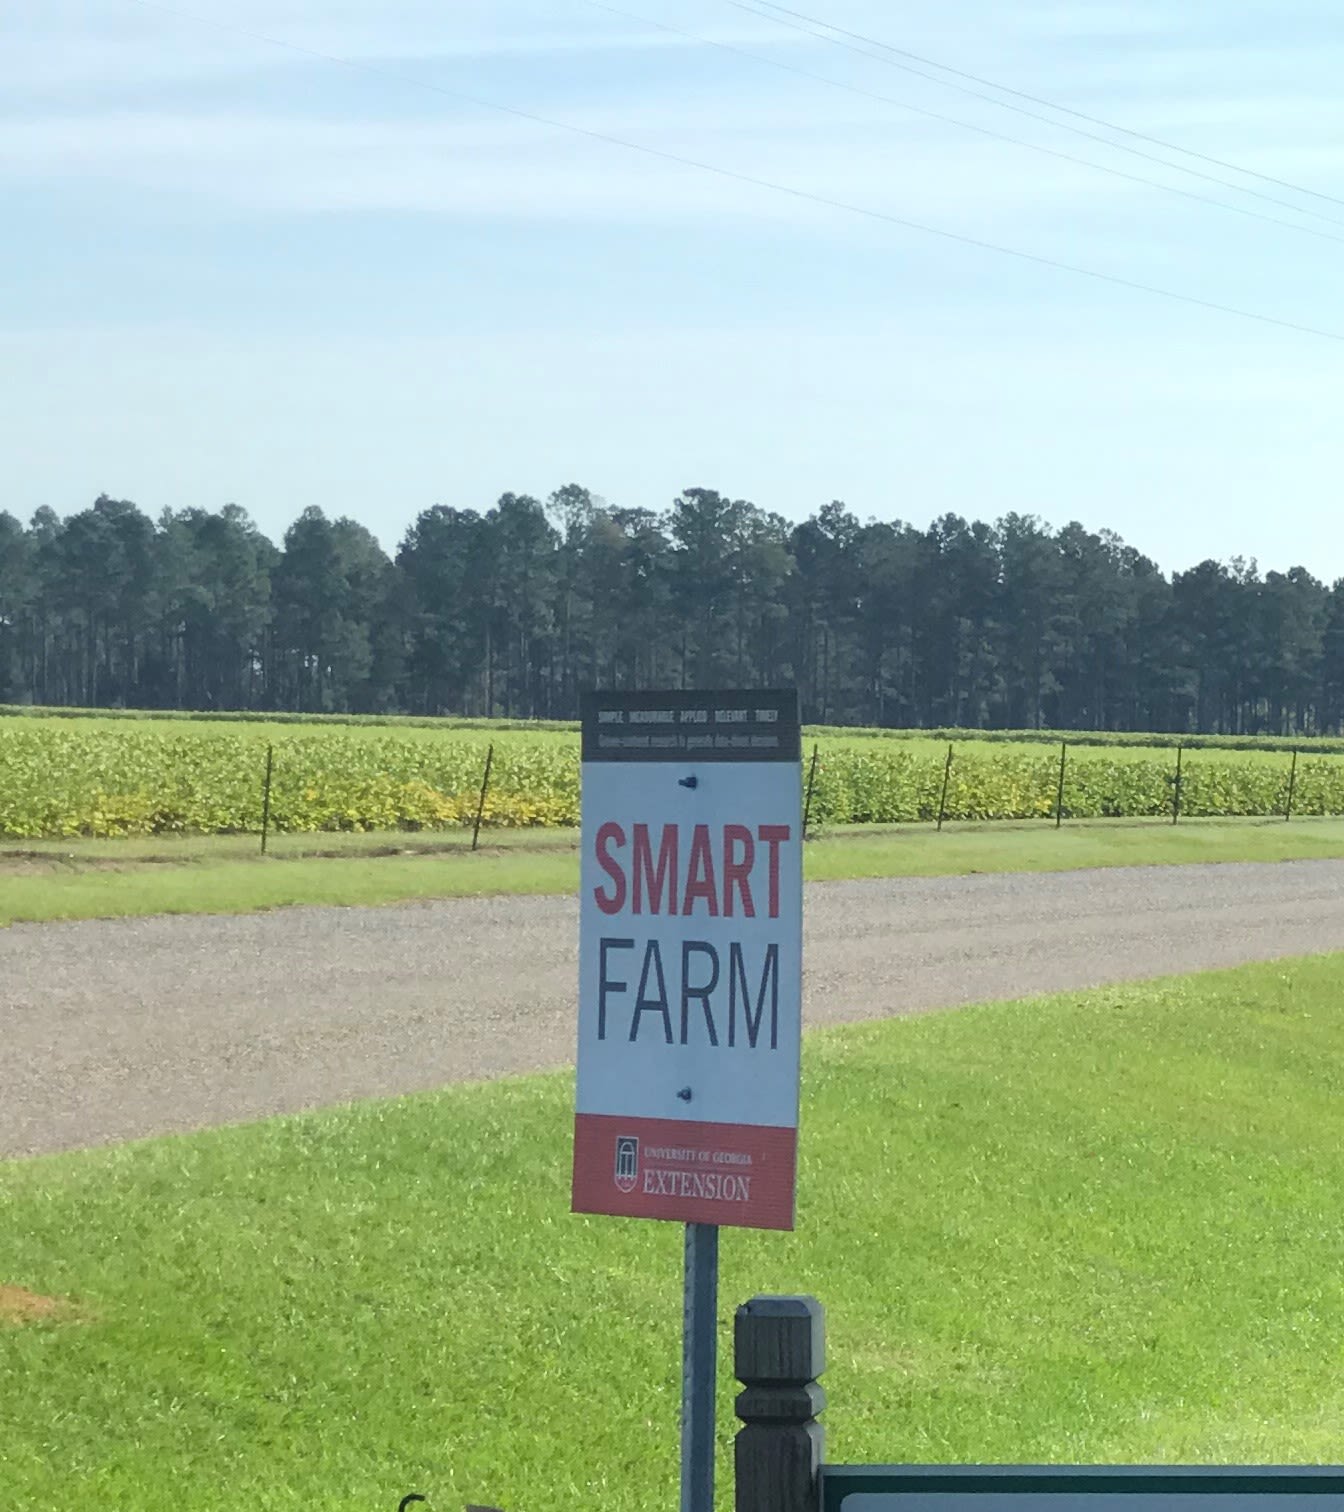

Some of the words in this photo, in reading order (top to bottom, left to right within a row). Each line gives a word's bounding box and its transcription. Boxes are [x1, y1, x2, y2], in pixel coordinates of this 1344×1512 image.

[594, 821, 791, 919] SMART
[597, 937, 780, 1050] FARM
[642, 1169, 752, 1201] EXTENSION
[644, 1147, 696, 1161] UNIVERSITY
[698, 1151, 710, 1162] OF
[712, 1152, 752, 1165] GEORGIA
